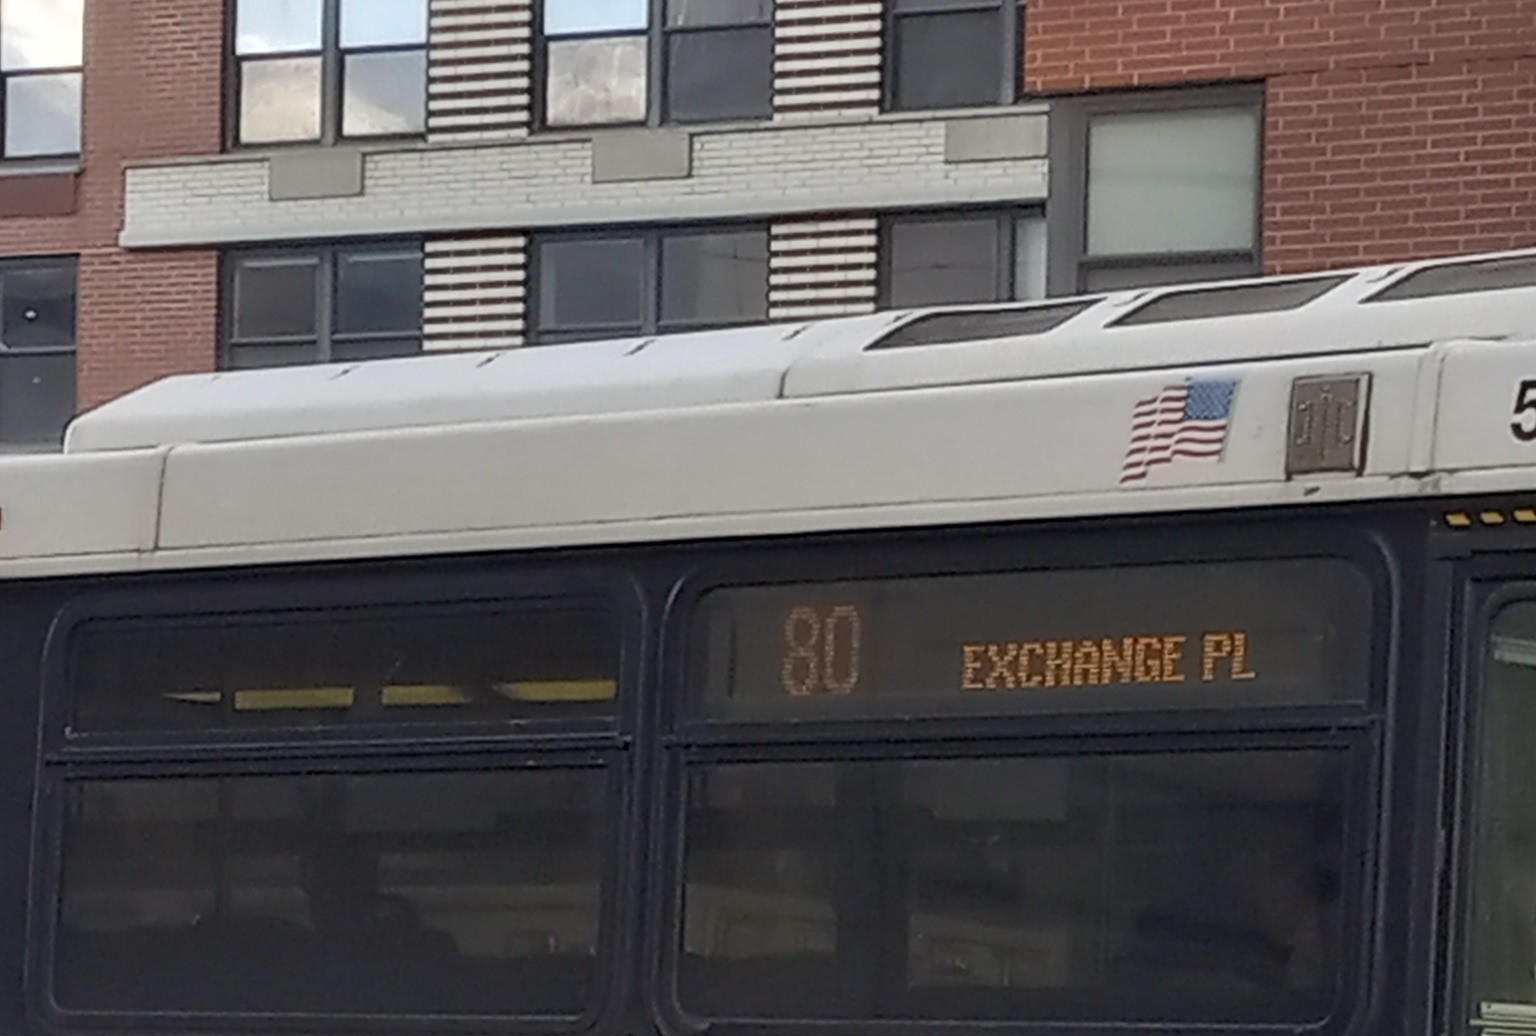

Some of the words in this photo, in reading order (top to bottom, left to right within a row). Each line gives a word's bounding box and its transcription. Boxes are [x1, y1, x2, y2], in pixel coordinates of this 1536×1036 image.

[783, 606, 860, 696] 80
[963, 636, 1186, 690] EXCHANGE
[1202, 632, 1256, 681] PL
